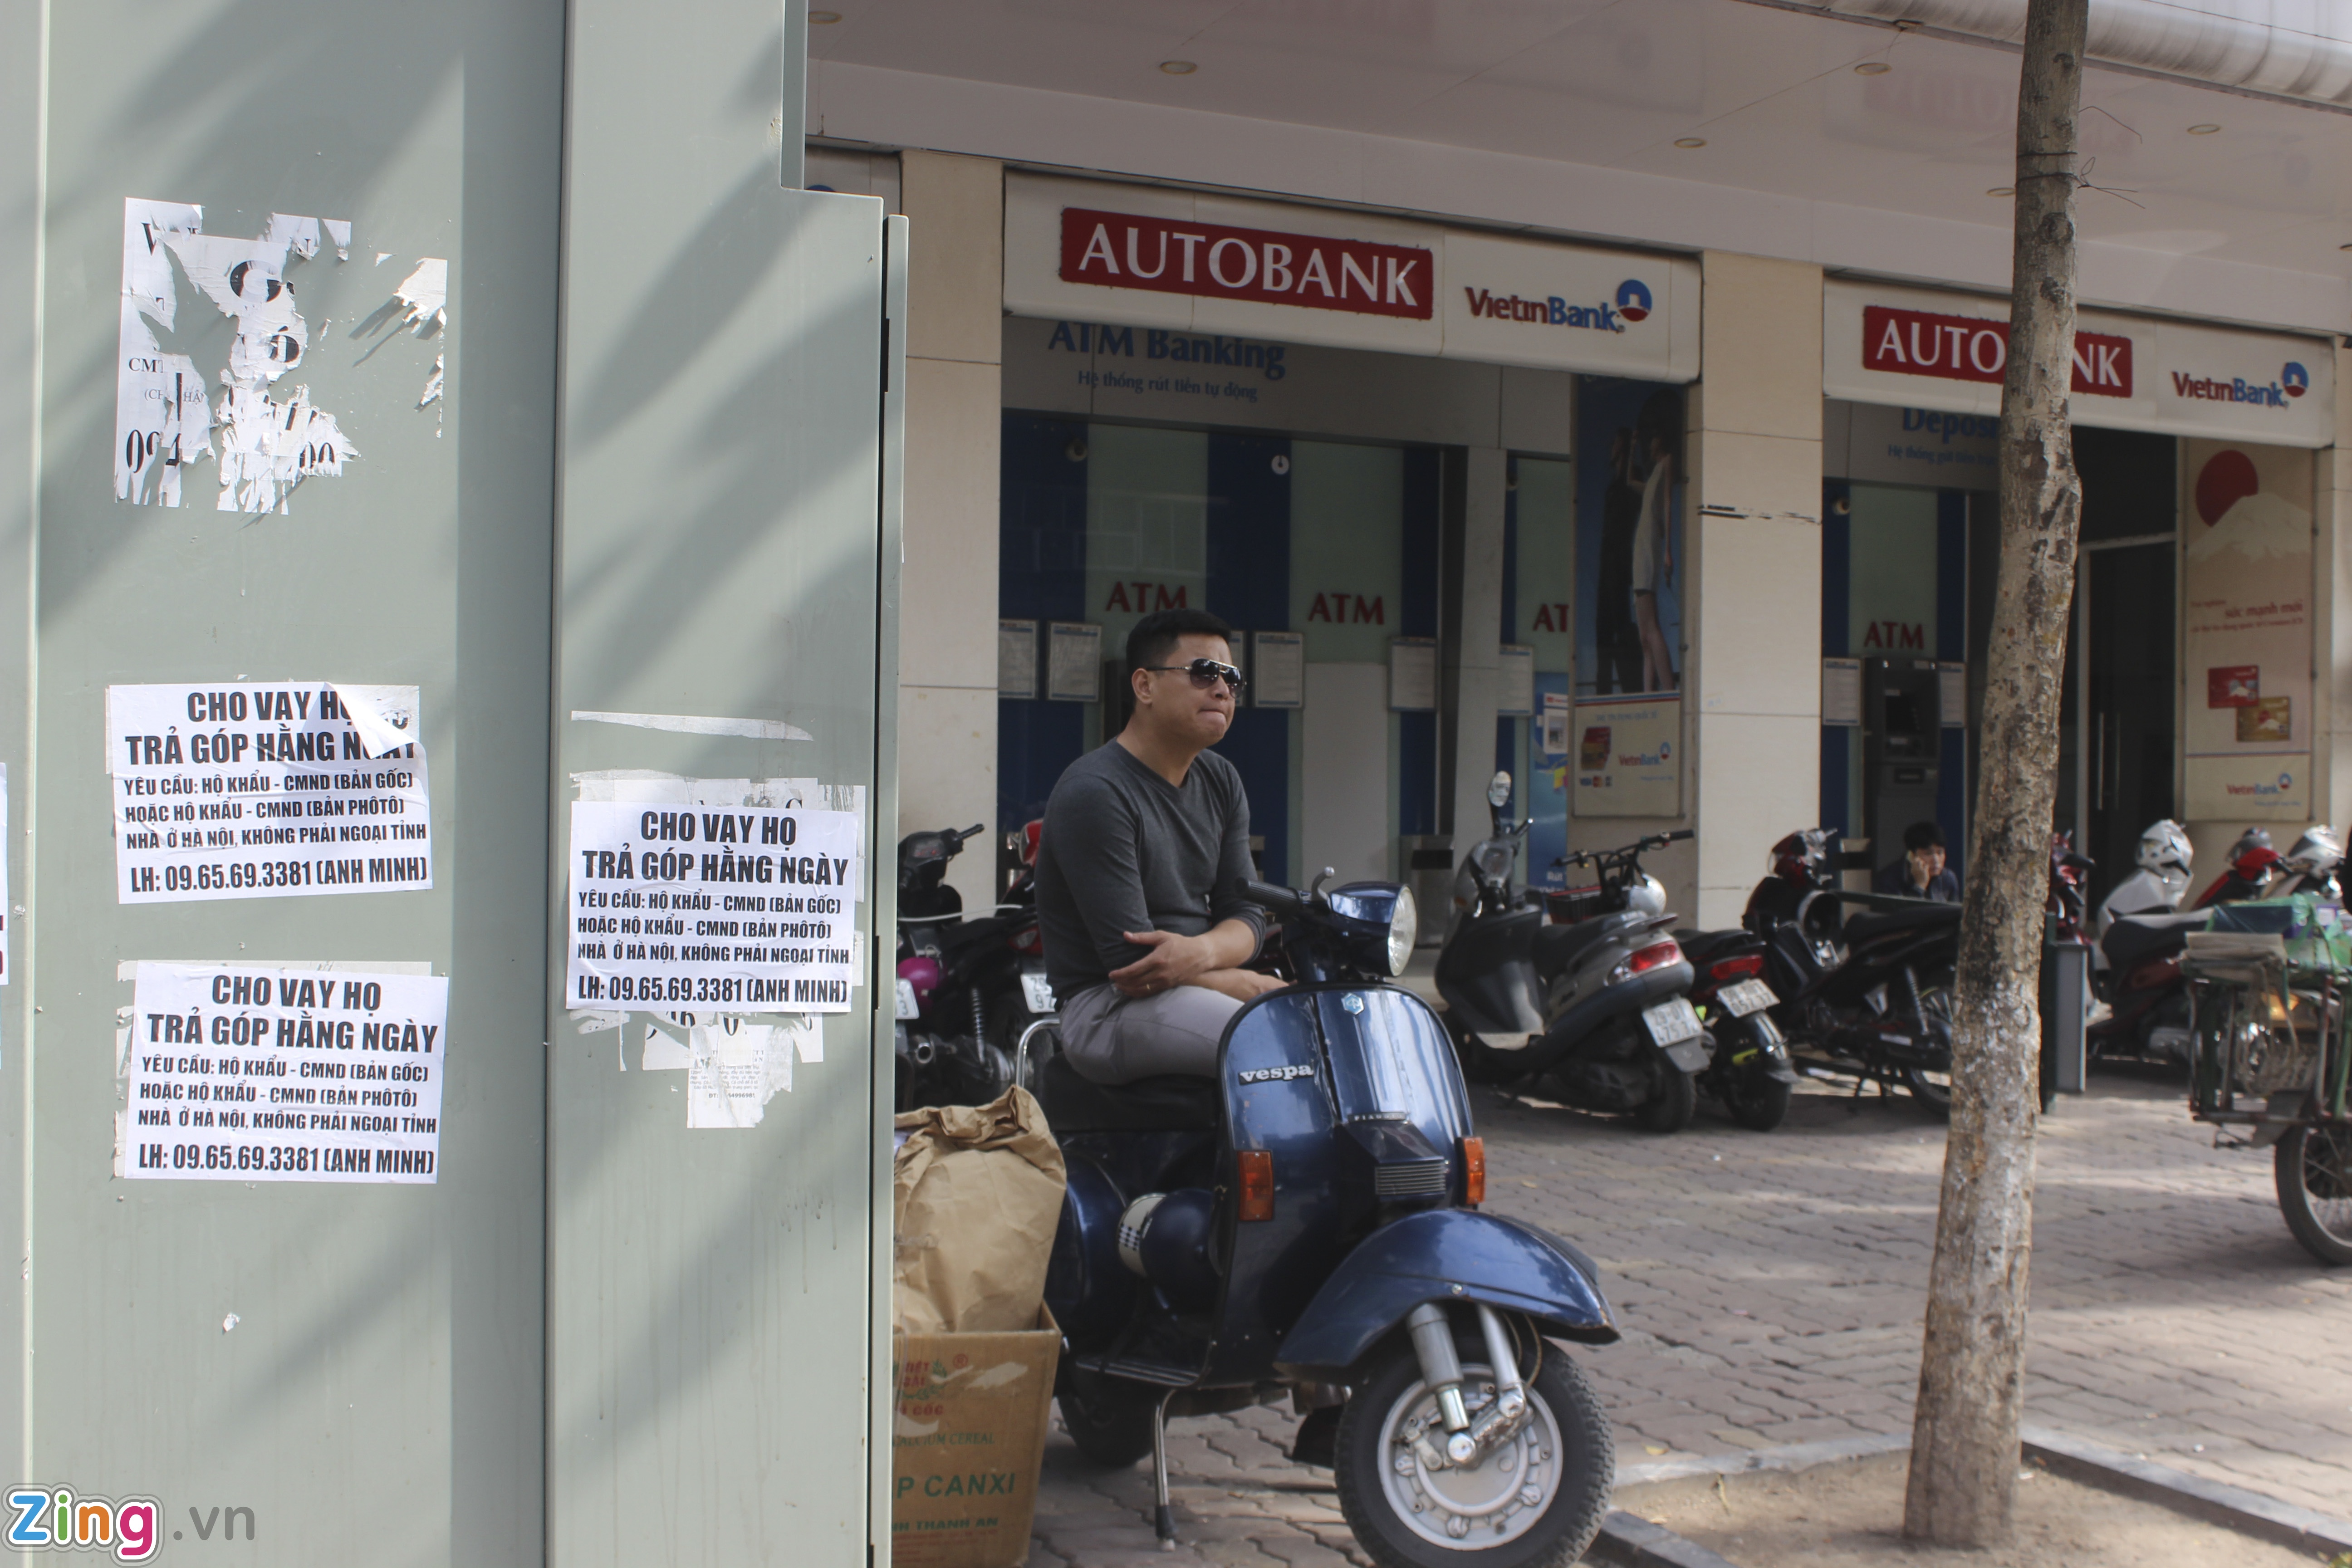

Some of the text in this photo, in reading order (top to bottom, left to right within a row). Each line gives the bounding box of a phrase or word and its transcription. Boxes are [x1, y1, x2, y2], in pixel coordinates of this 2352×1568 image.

[1078, 223, 1418, 307] AUTOBANK
[1465, 286, 1619, 332] VietinBank
[1048, 320, 1286, 381] ATM Banking
[1877, 319, 2122, 387] AUTONK
[1078, 370, 1099, 389] Hệ
[1103, 372, 1144, 394] thống
[1148, 375, 1169, 392] rút
[1205, 380, 1220, 398] tự
[1224, 381, 1258, 402] động
[2171, 371, 2285, 407] VietinBank
[1106, 581, 1188, 613] ATM
[1308, 593, 1385, 626] ATM
[1533, 603, 1569, 632] AT
[1863, 621, 1924, 650] ATM
[187, 691, 247, 722] CHO
[254, 691, 311, 720] VAY
[125, 723, 415, 765] TRẢ GÓP HẰNG NY
[124, 767, 413, 797] YÊU CẦU: HỘ KHẨU CMND (BẢN GỐC)
[125, 795, 404, 825] HOẶC HỘ KHẨU CMND (BẢN PHÔTÔ)
[127, 819, 426, 850] NHÀ Ở HÀ NỘI, KHÔNG PHẢI NGOẠI TỈNH
[641, 811, 797, 851] CHO VAY HỌ
[131, 857, 427, 892] LH: 09.65.69.3381 (ANH MINH)
[582, 842, 849, 886] TRẢ GÓP HẰNG NGÀY
[578, 888, 841, 914] YÊU CẦU: HỘ KHẨU CMND (BẢN GỐC)
[578, 913, 831, 939] HOẶC HỘ KHẨU CMND (BẢN PHÔTÔ)
[578, 939, 849, 966] NHÀ Ở HÀ NỘI, KHÔNG PHẢI NGOẠI TỈNH
[212, 975, 381, 1017] CHO VAY HỌ
[578, 975, 847, 1003] LH: 09.65.69.3381 (ANH MINH)
[147, 1006, 438, 1054] TRẢ GÓP HẰNG NGÀY
[142, 1054, 428, 1082] YÊU CẦU: HỘ KHẨU CMND (BẢN GỐC)
[1240, 1064, 1314, 1083] vespa
[140, 1079, 417, 1107] HOẶC HỘ KHẨU CMND (BẢN PHÔTÔ)
[138, 1106, 436, 1136] NHÀ Ở HÀ NỘI, KHÔNG PHẢI NGOẠI TỈNH
[139, 1143, 434, 1174] LH: 09.65.69.3381 (ANH MINH)
[924, 1472, 1016, 1498] CANXI
